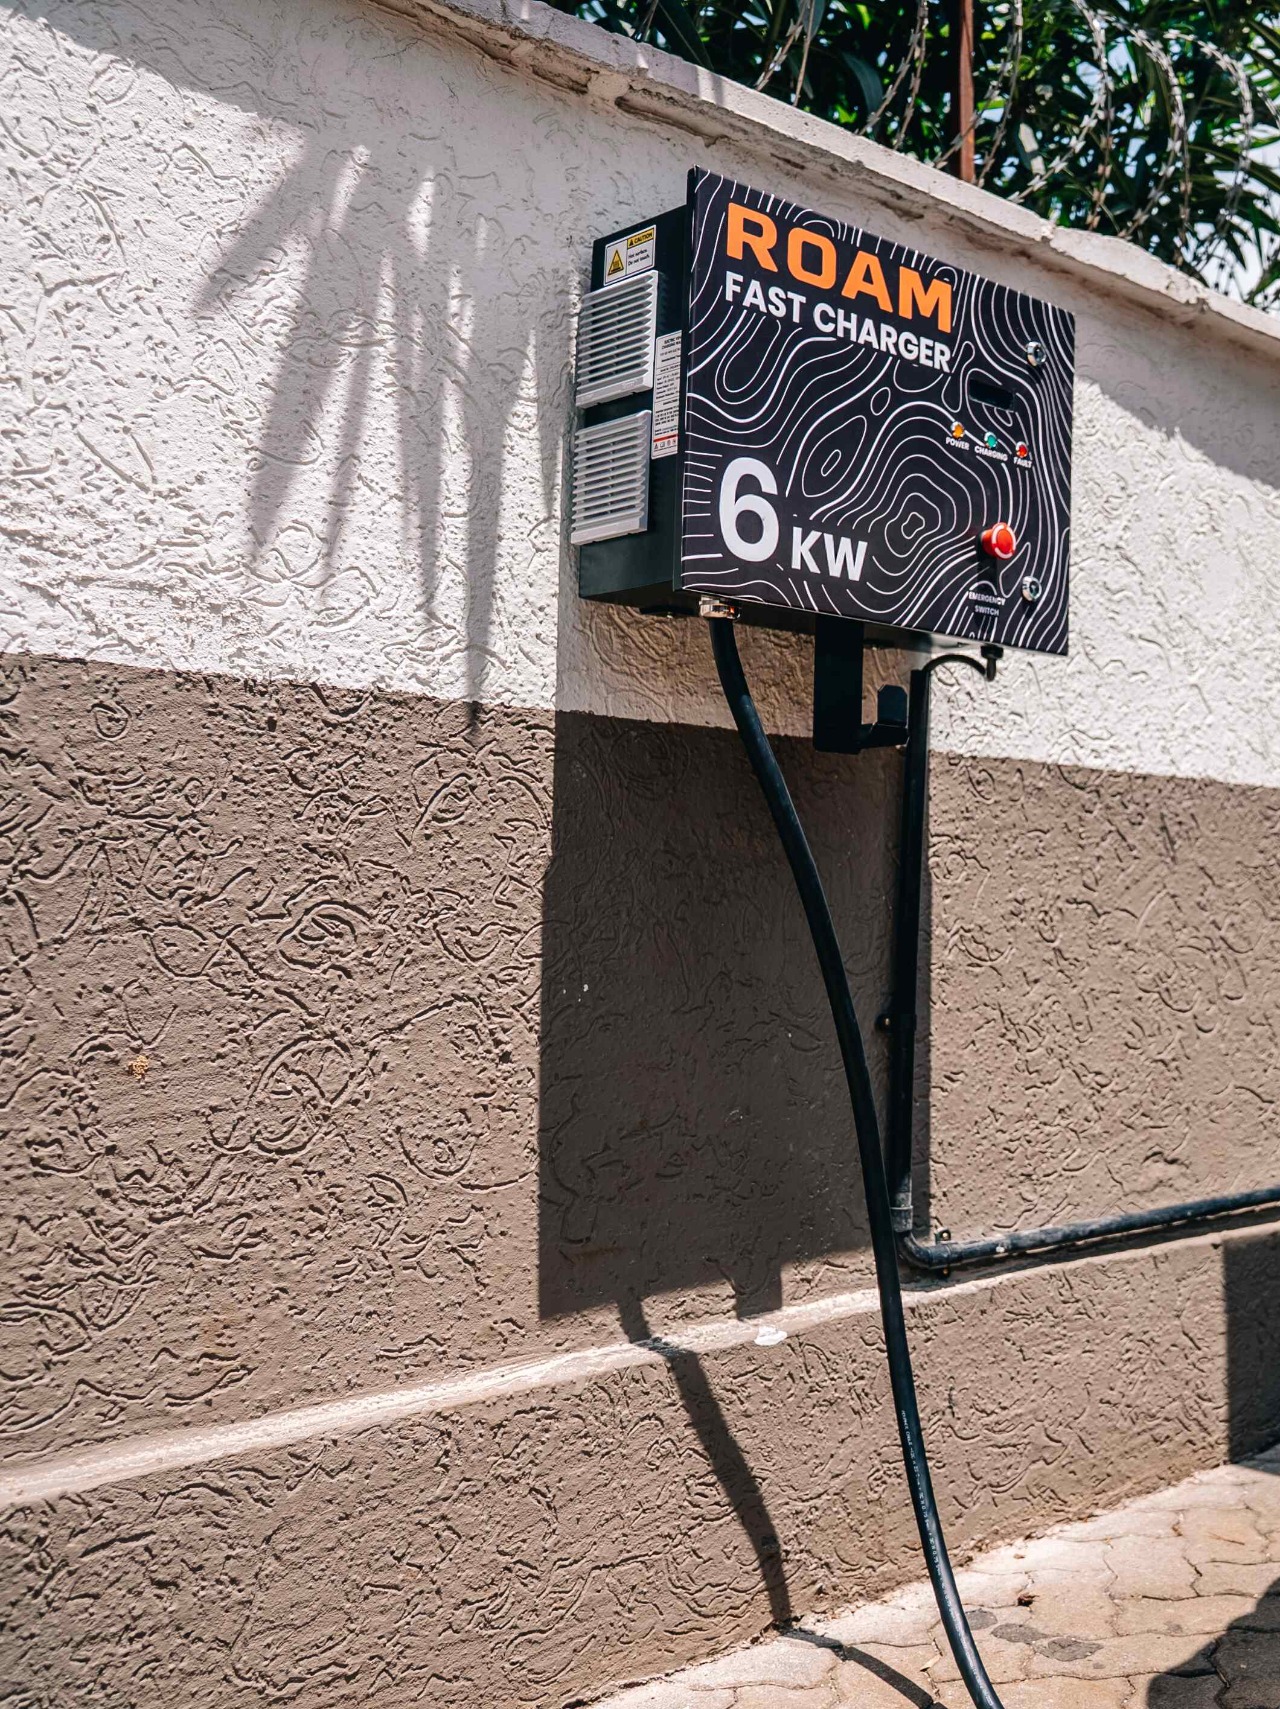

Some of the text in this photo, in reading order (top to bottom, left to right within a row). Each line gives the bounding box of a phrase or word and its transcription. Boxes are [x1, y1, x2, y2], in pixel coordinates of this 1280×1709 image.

[634, 232, 653, 243] CAUTION
[727, 203, 953, 333] ROAM
[725, 270, 951, 374] FAST CHARGER
[945, 436, 970, 451] POWER
[974, 445, 1008, 461] CHARGING
[1013, 456, 1033, 469] FAULT
[719, 457, 868, 583] 6 KW
[969, 591, 1006, 606] EMERGENCY
[974, 604, 1000, 616] SWITCH
